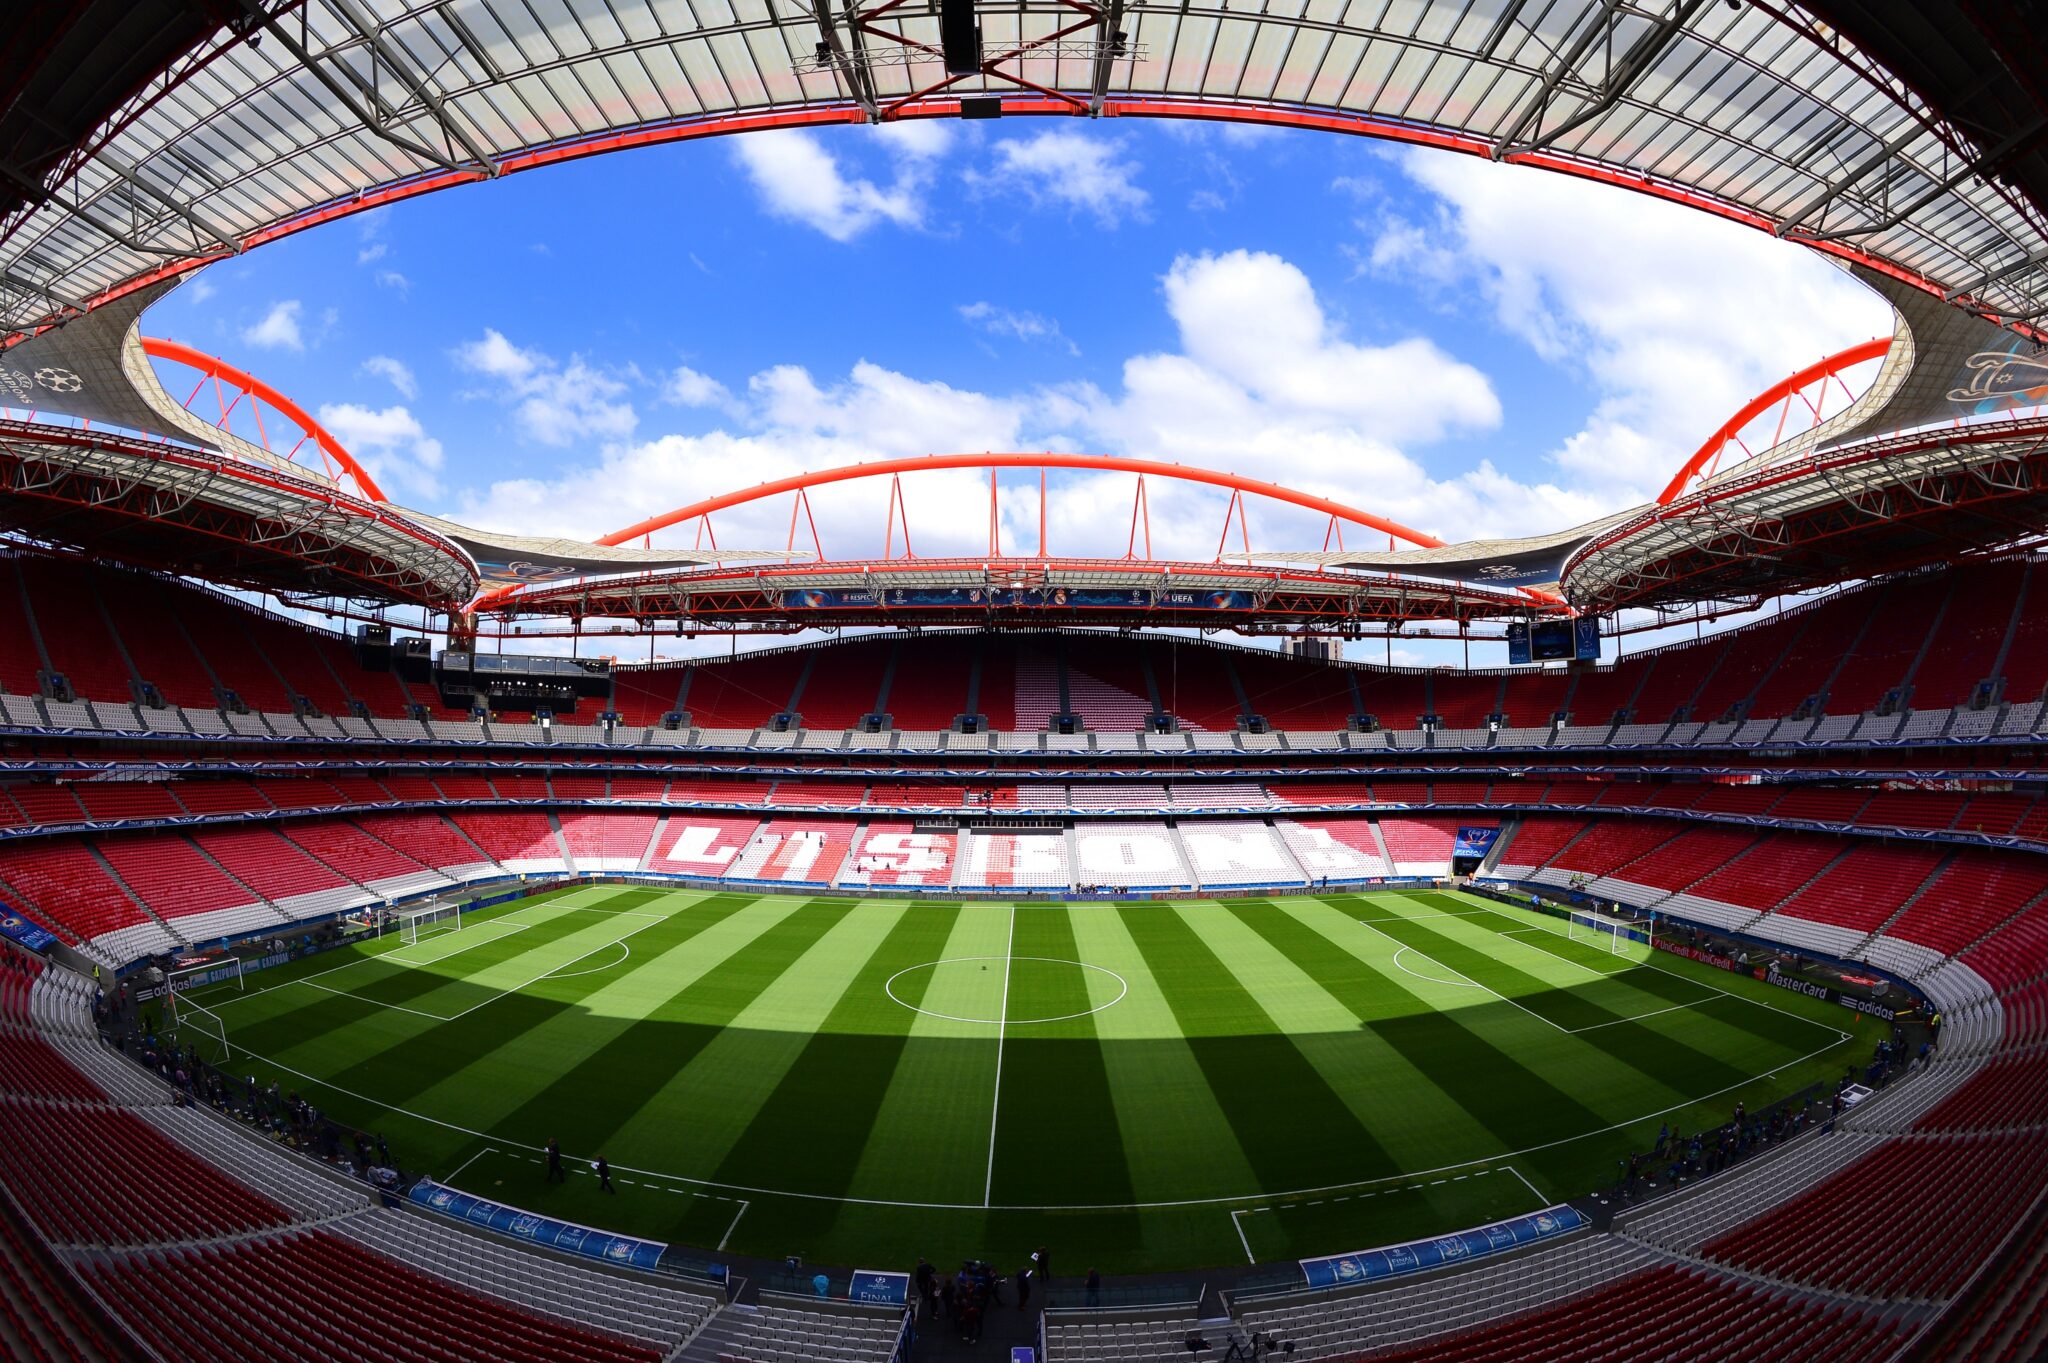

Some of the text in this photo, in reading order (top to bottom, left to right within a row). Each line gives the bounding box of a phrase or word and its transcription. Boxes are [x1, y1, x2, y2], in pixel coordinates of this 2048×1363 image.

[627, 877, 675, 888] MasterCard
[926, 892, 967, 901] Heineken
[1077, 893, 1126, 902] PlayStation
[1163, 892, 1198, 900] UniCredit
[1210, 891, 1245, 899] UniCredit
[1282, 886, 1335, 896] MasterCard
[1660, 941, 1690, 957] UniCredit
[262, 952, 290, 969] GAZPROM
[1699, 952, 1731, 970] UniCredit
[210, 965, 240, 982] GAZPROM
[154, 980, 191, 997] adidas
[1767, 971, 1828, 999] MasterCard
[1857, 1000, 1895, 1021] adidas
[860, 1291, 892, 1303] FINAL
